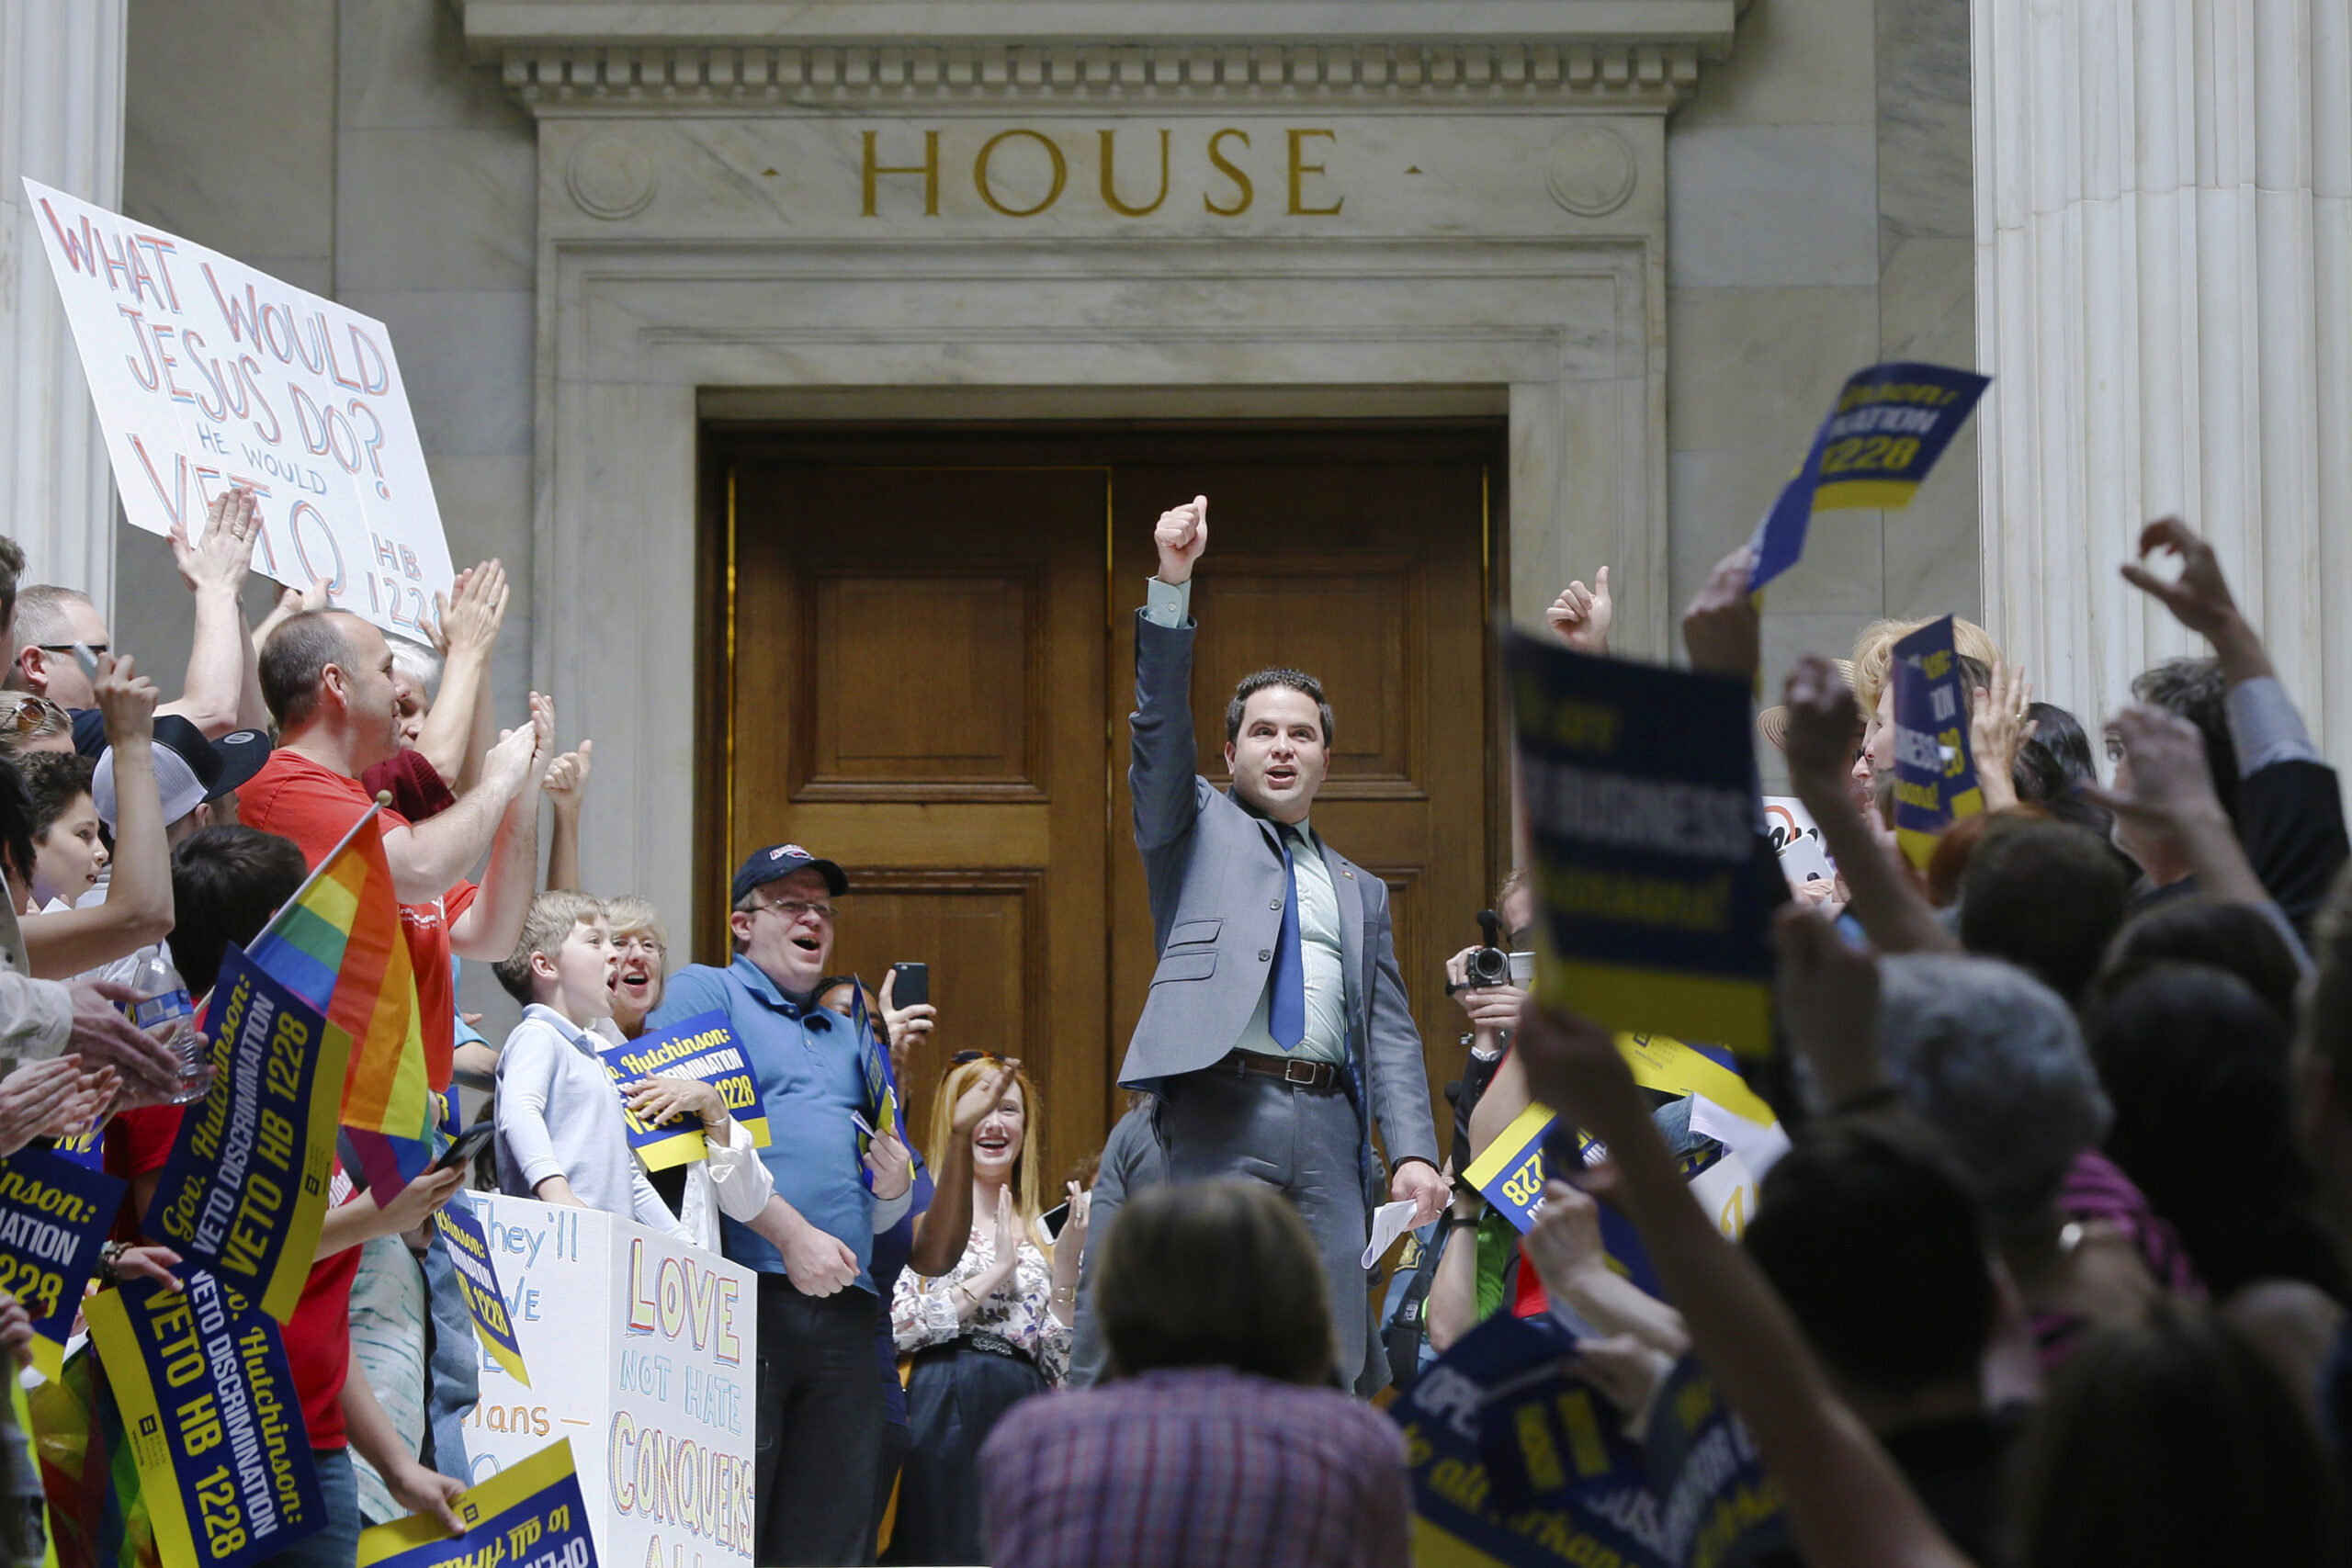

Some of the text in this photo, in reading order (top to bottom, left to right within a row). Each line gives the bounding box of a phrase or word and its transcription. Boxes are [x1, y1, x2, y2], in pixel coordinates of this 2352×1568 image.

[860, 128, 1344, 218] HOUSE
[39, 197, 389, 396] WHAT WOULD
[118, 303, 387, 502] JESUS DO?
[197, 423, 327, 495] HE WOULD
[370, 532, 422, 581] HB
[620, 1029, 731, 1075] Hutchinson:
[162, 973, 251, 1241] Gov. Hutchinson:
[192, 991, 276, 1256] VETO DISCRIMINATION
[714, 1075, 756, 1110] 1228
[220, 1012, 309, 1277] VETO HB 1228
[1501, 1147, 1546, 1207] 228
[0, 1159, 96, 1224] nson:
[0, 1207, 81, 1267] ATION
[469, 1197, 579, 1270] They'll
[0, 1253, 63, 1318] 228
[474, 1286, 510, 1337] 1228
[627, 1238, 741, 1367] LOVE
[144, 1278, 206, 1388] VETO
[176, 1392, 223, 1457] HB
[190, 1269, 278, 1540] VETO DISCRIMINATION
[240, 1326, 304, 1525] Hutchinson:
[620, 1349, 741, 1436] NOT HATE
[195, 1465, 247, 1560] 1228
[548, 1505, 571, 1532] to
[609, 1411, 754, 1559] CONQUERS
[507, 1516, 541, 1561] all
[525, 1536, 589, 1568] OPE
